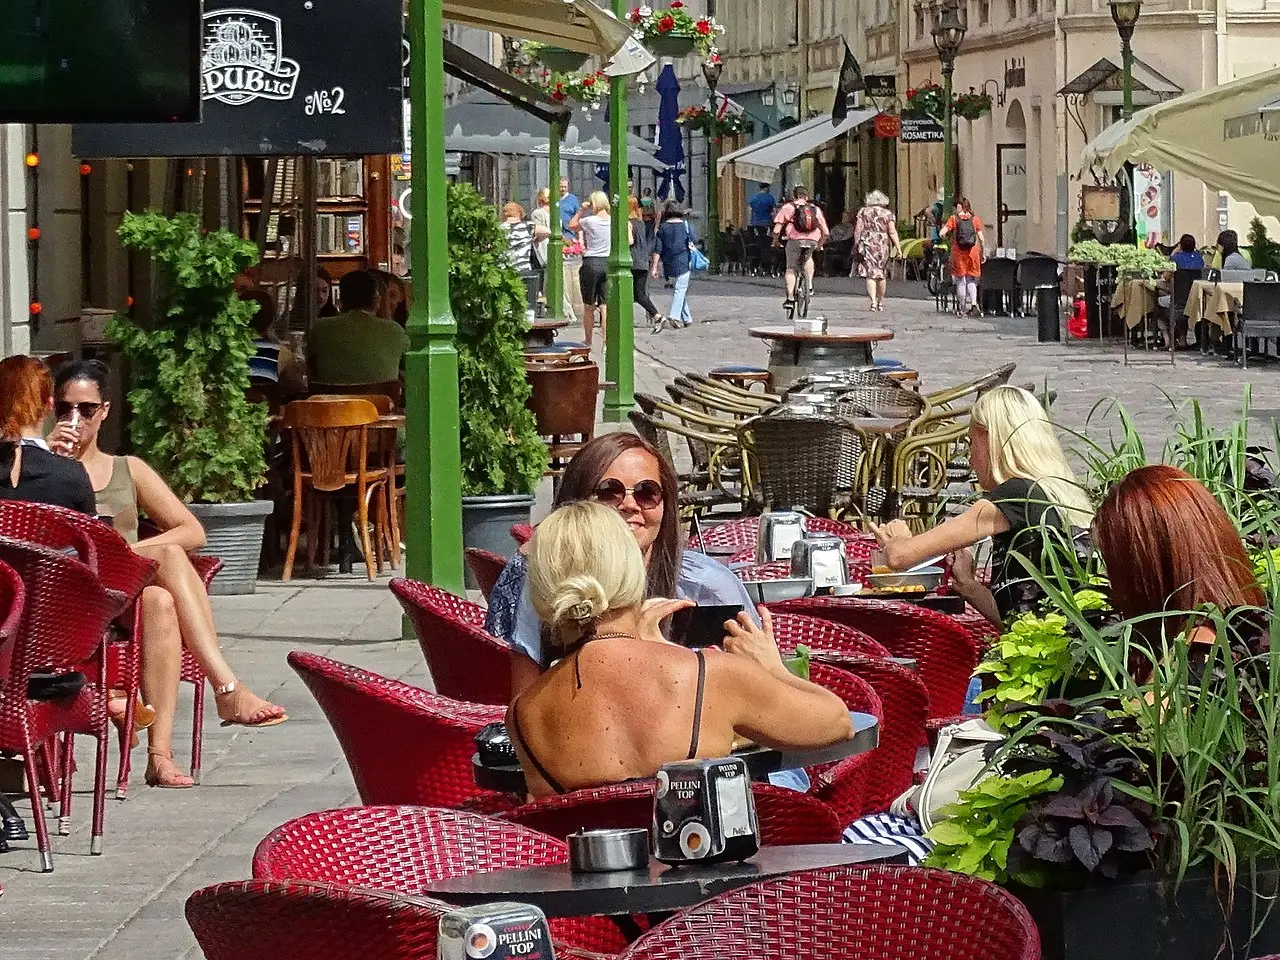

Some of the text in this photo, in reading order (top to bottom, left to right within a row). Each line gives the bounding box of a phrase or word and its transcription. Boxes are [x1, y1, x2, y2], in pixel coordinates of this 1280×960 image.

[202, 67, 291, 95] PUBLIC
[902, 131, 945, 140] KOSMETIKA
[718, 764, 738, 773] PELLINI
[670, 780, 701, 790] PELLINI
[678, 790, 694, 799] TOP
[498, 928, 542, 945] PELLINI
[508, 942, 534, 955] TOP
